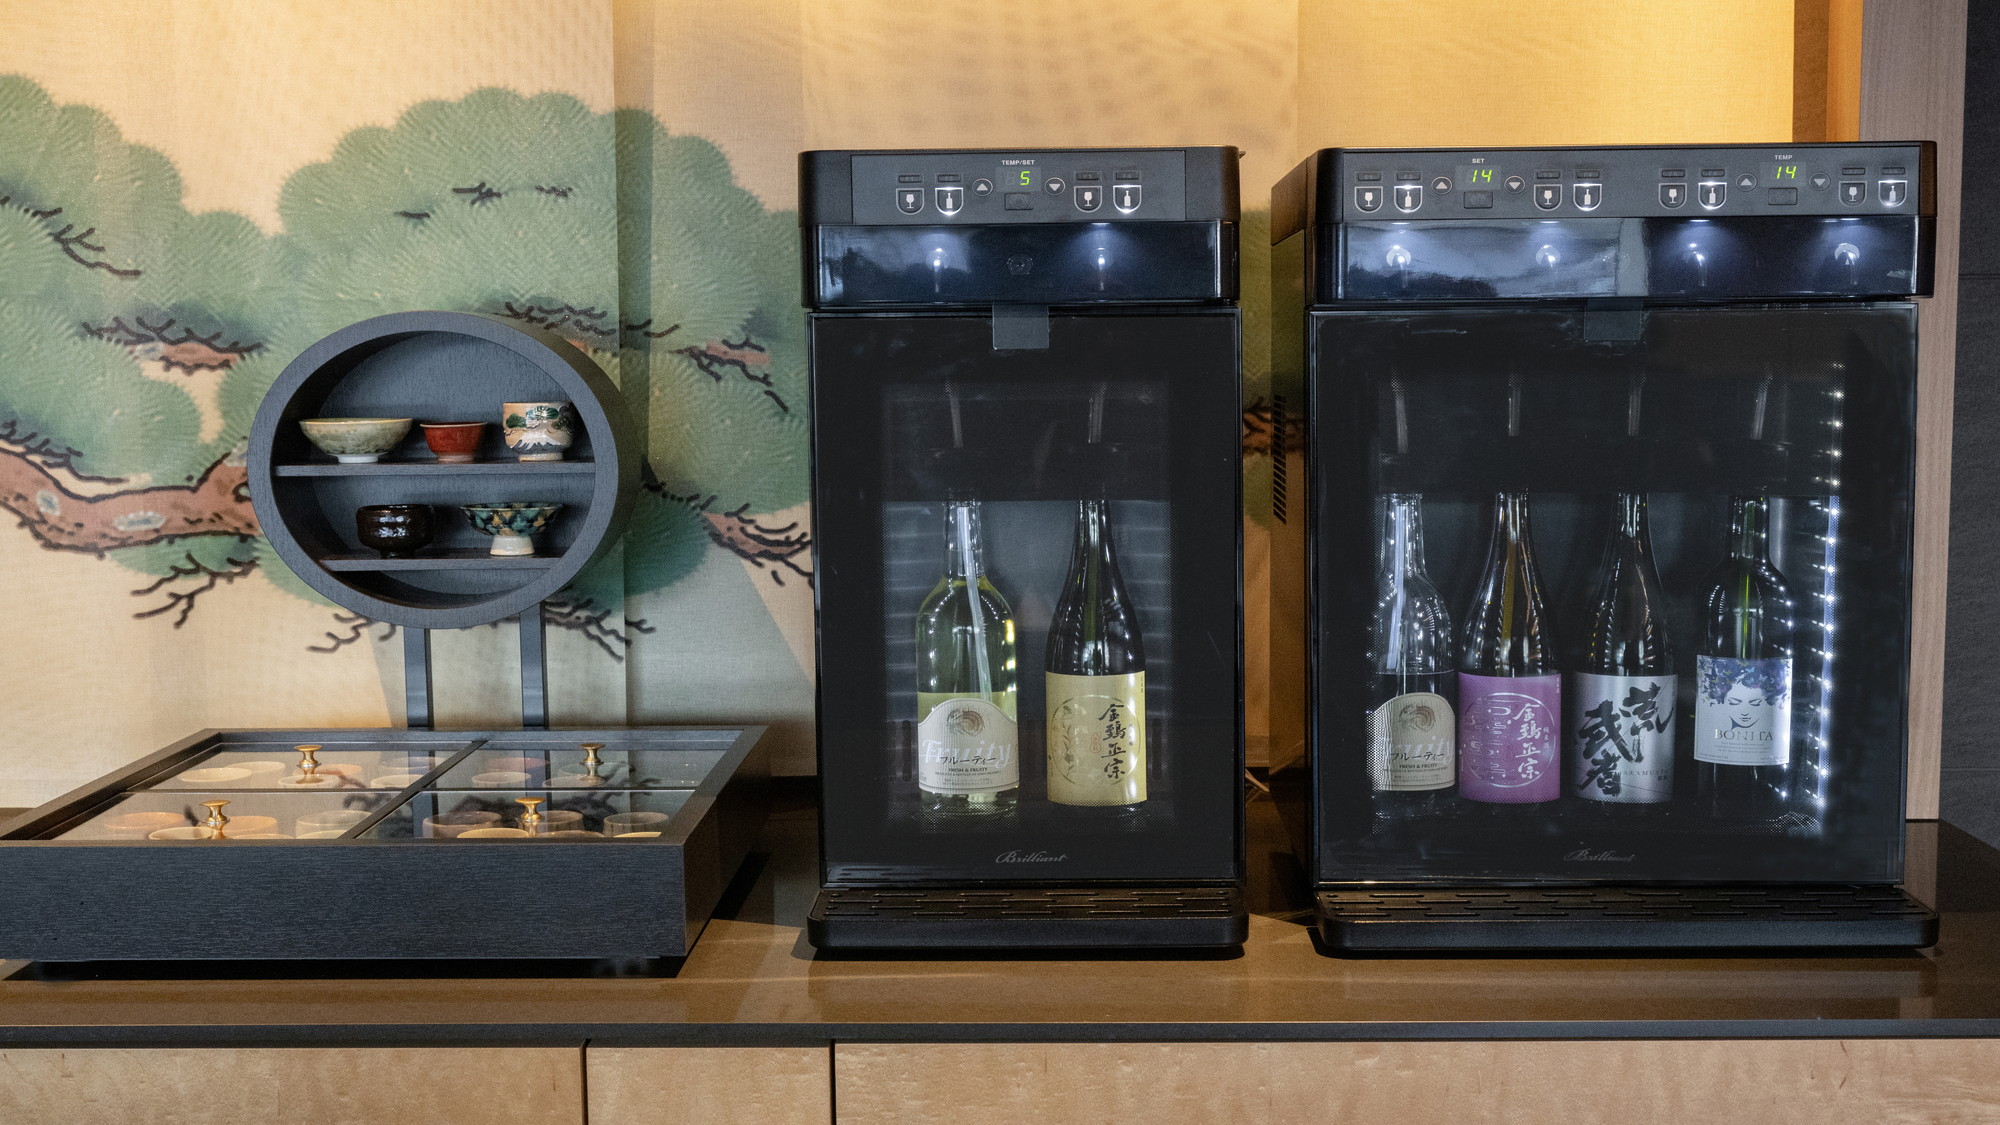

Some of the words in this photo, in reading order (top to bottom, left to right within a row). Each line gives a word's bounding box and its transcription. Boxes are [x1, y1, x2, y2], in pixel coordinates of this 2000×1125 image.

[1020, 170, 1031, 186] 5
[1472, 169, 1493, 183] 14
[1776, 166, 1797, 179] 14
[1714, 728, 1774, 741] BONITA
[922, 739, 1012, 769] Fruity
[940, 755, 997, 765] フルーティー
[1389, 751, 1446, 761] フルーティー
[995, 849, 1069, 864] Brilliant
